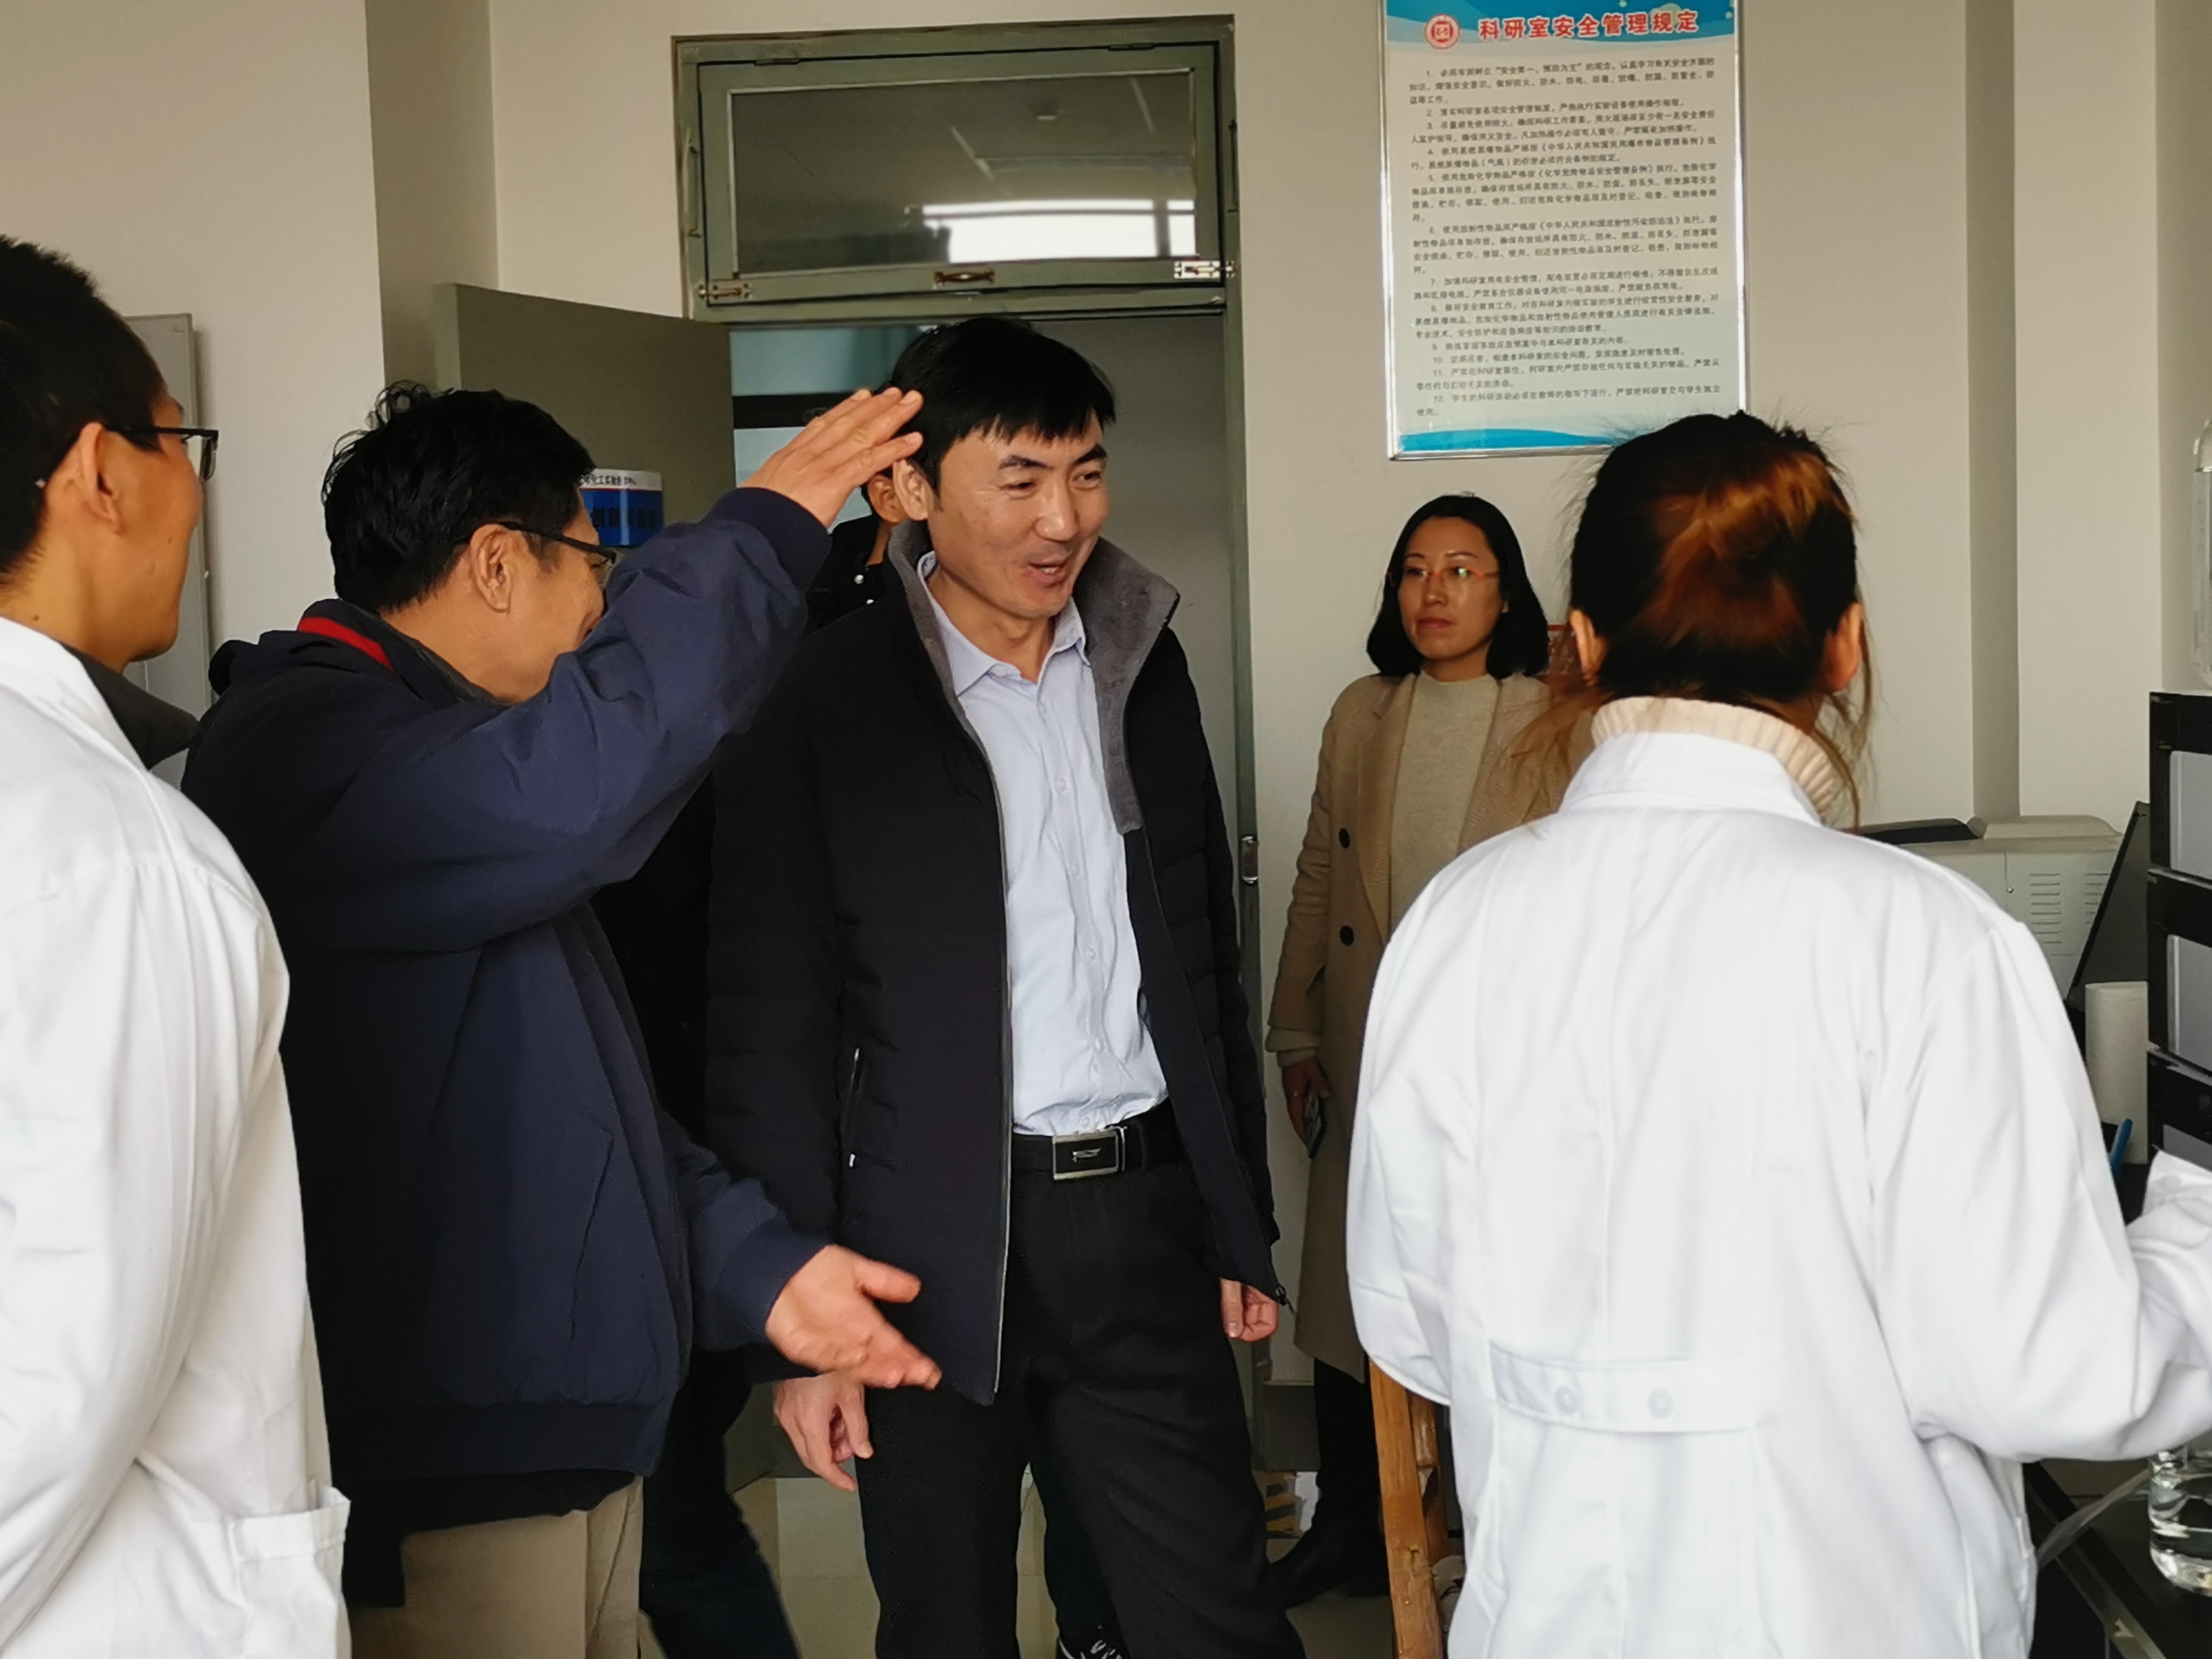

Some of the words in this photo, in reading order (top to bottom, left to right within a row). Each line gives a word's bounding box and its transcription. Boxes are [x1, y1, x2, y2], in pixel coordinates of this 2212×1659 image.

[1479, 11, 1699, 40] 科研室安全管理规定
